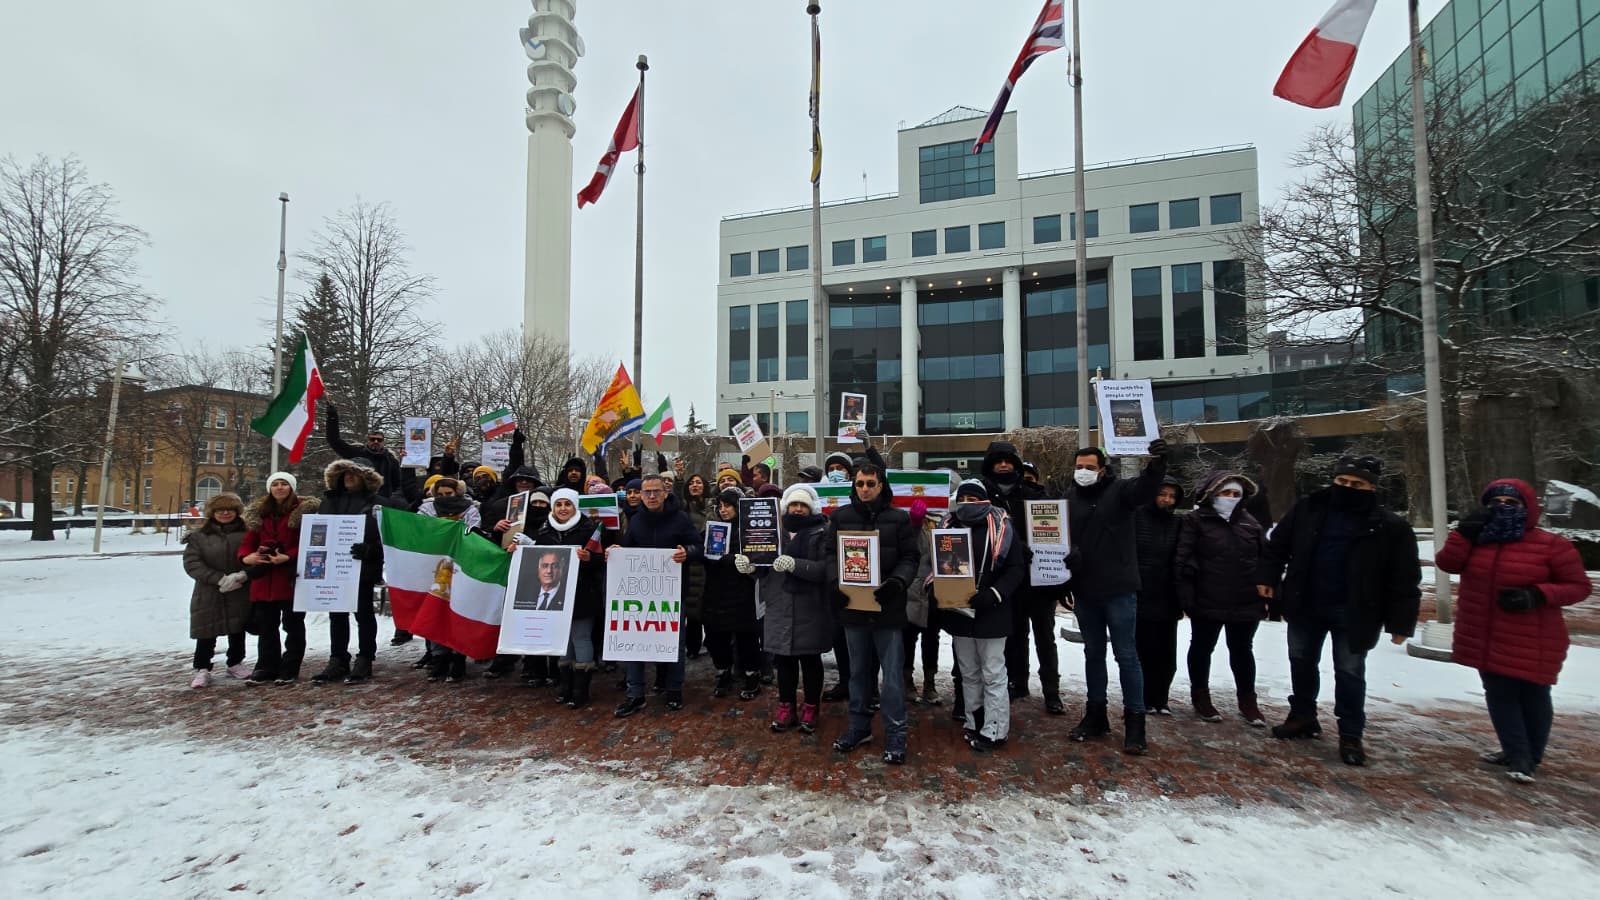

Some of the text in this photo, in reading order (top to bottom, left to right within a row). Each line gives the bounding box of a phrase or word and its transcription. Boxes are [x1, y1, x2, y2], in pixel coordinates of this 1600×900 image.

[625, 554, 672, 573] TALK
[616, 576, 678, 596] ABOUT
[610, 600, 679, 632] IRAN
[608, 635, 634, 652] Hear
